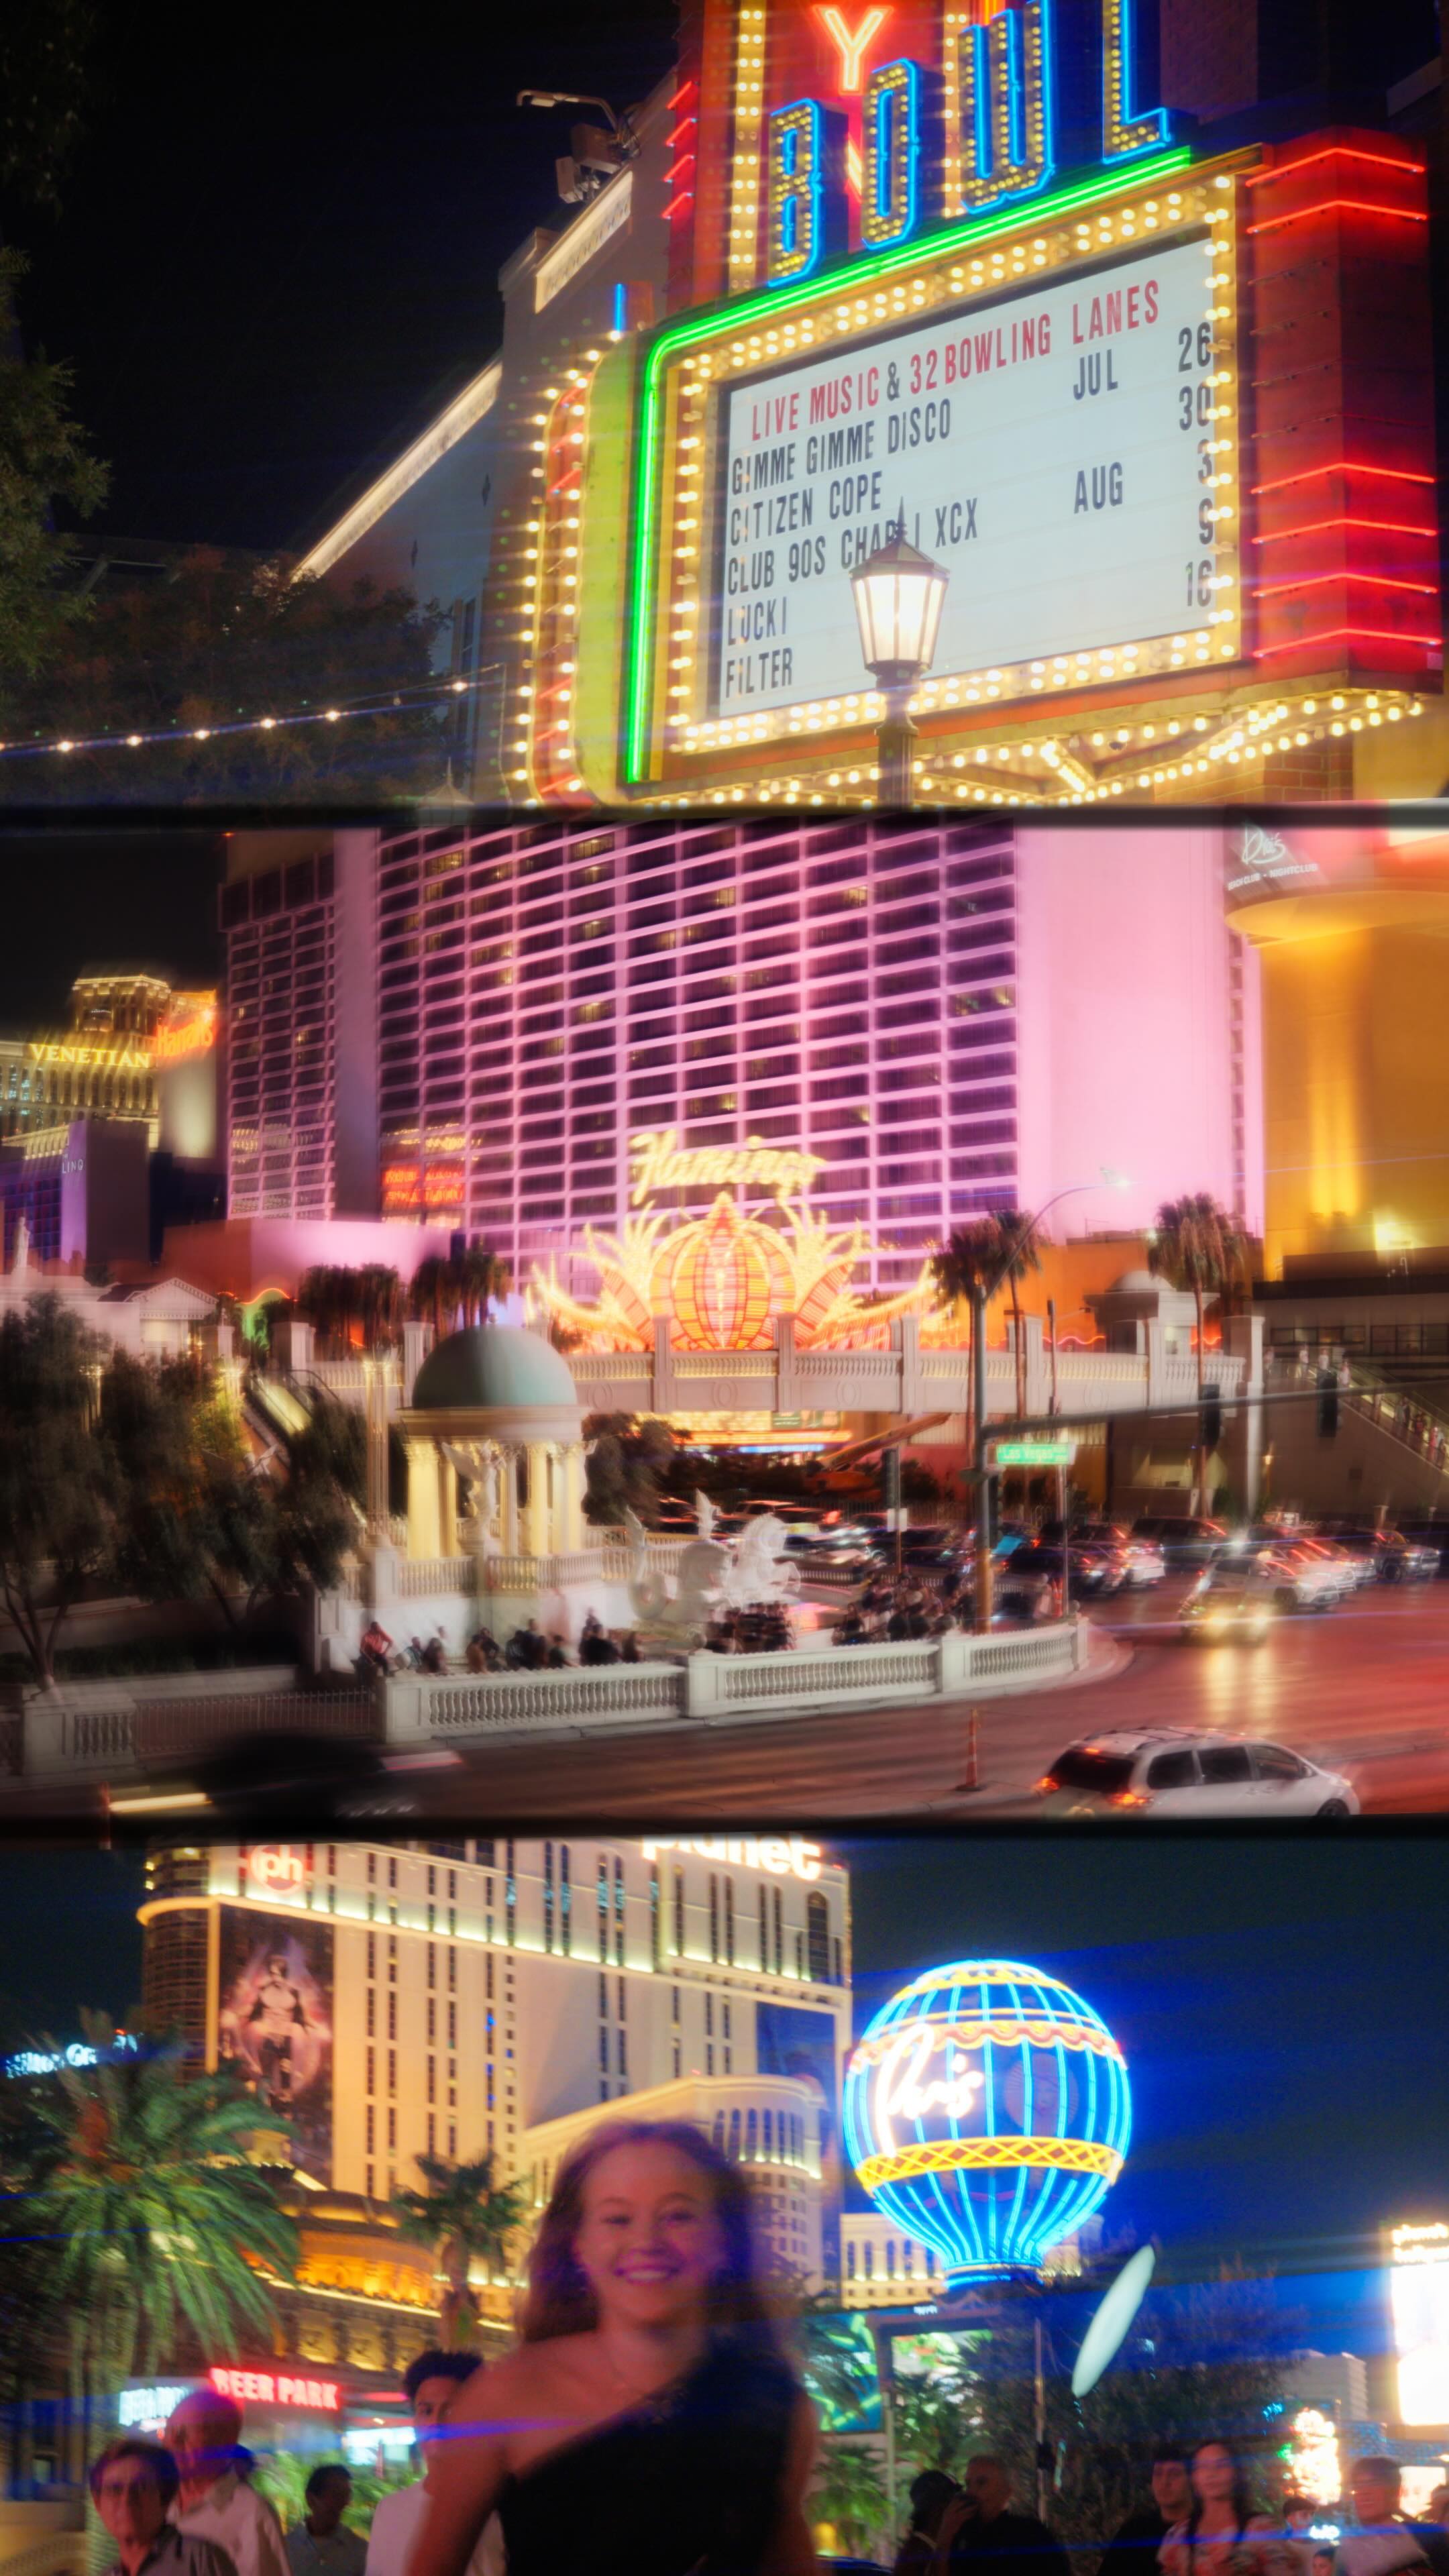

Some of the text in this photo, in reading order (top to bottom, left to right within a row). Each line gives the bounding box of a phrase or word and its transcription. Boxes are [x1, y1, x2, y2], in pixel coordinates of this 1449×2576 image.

[767, 0, 1172, 287] BOWL
[731, 322, 1212, 496] GIMME GIMME DISCO JUL 26
[751, 279, 1159, 441] LIVE MUSIC & 32 BOWLING LANES
[727, 438, 1213, 596] CLUB 90S CHARI XCX AUG 3
[730, 381, 1212, 547] CITIZEN COPE 30
[725, 559, 1213, 698] FILTER 16
[727, 498, 1214, 646] LUCKI 9
[1269, 863, 1319, 878] NIGHTCLUB
[29, 1043, 151, 1069] VENETIAN
[62, 1159, 84, 1174] LINQ
[210, 2367, 338, 2410] BEER PARK
